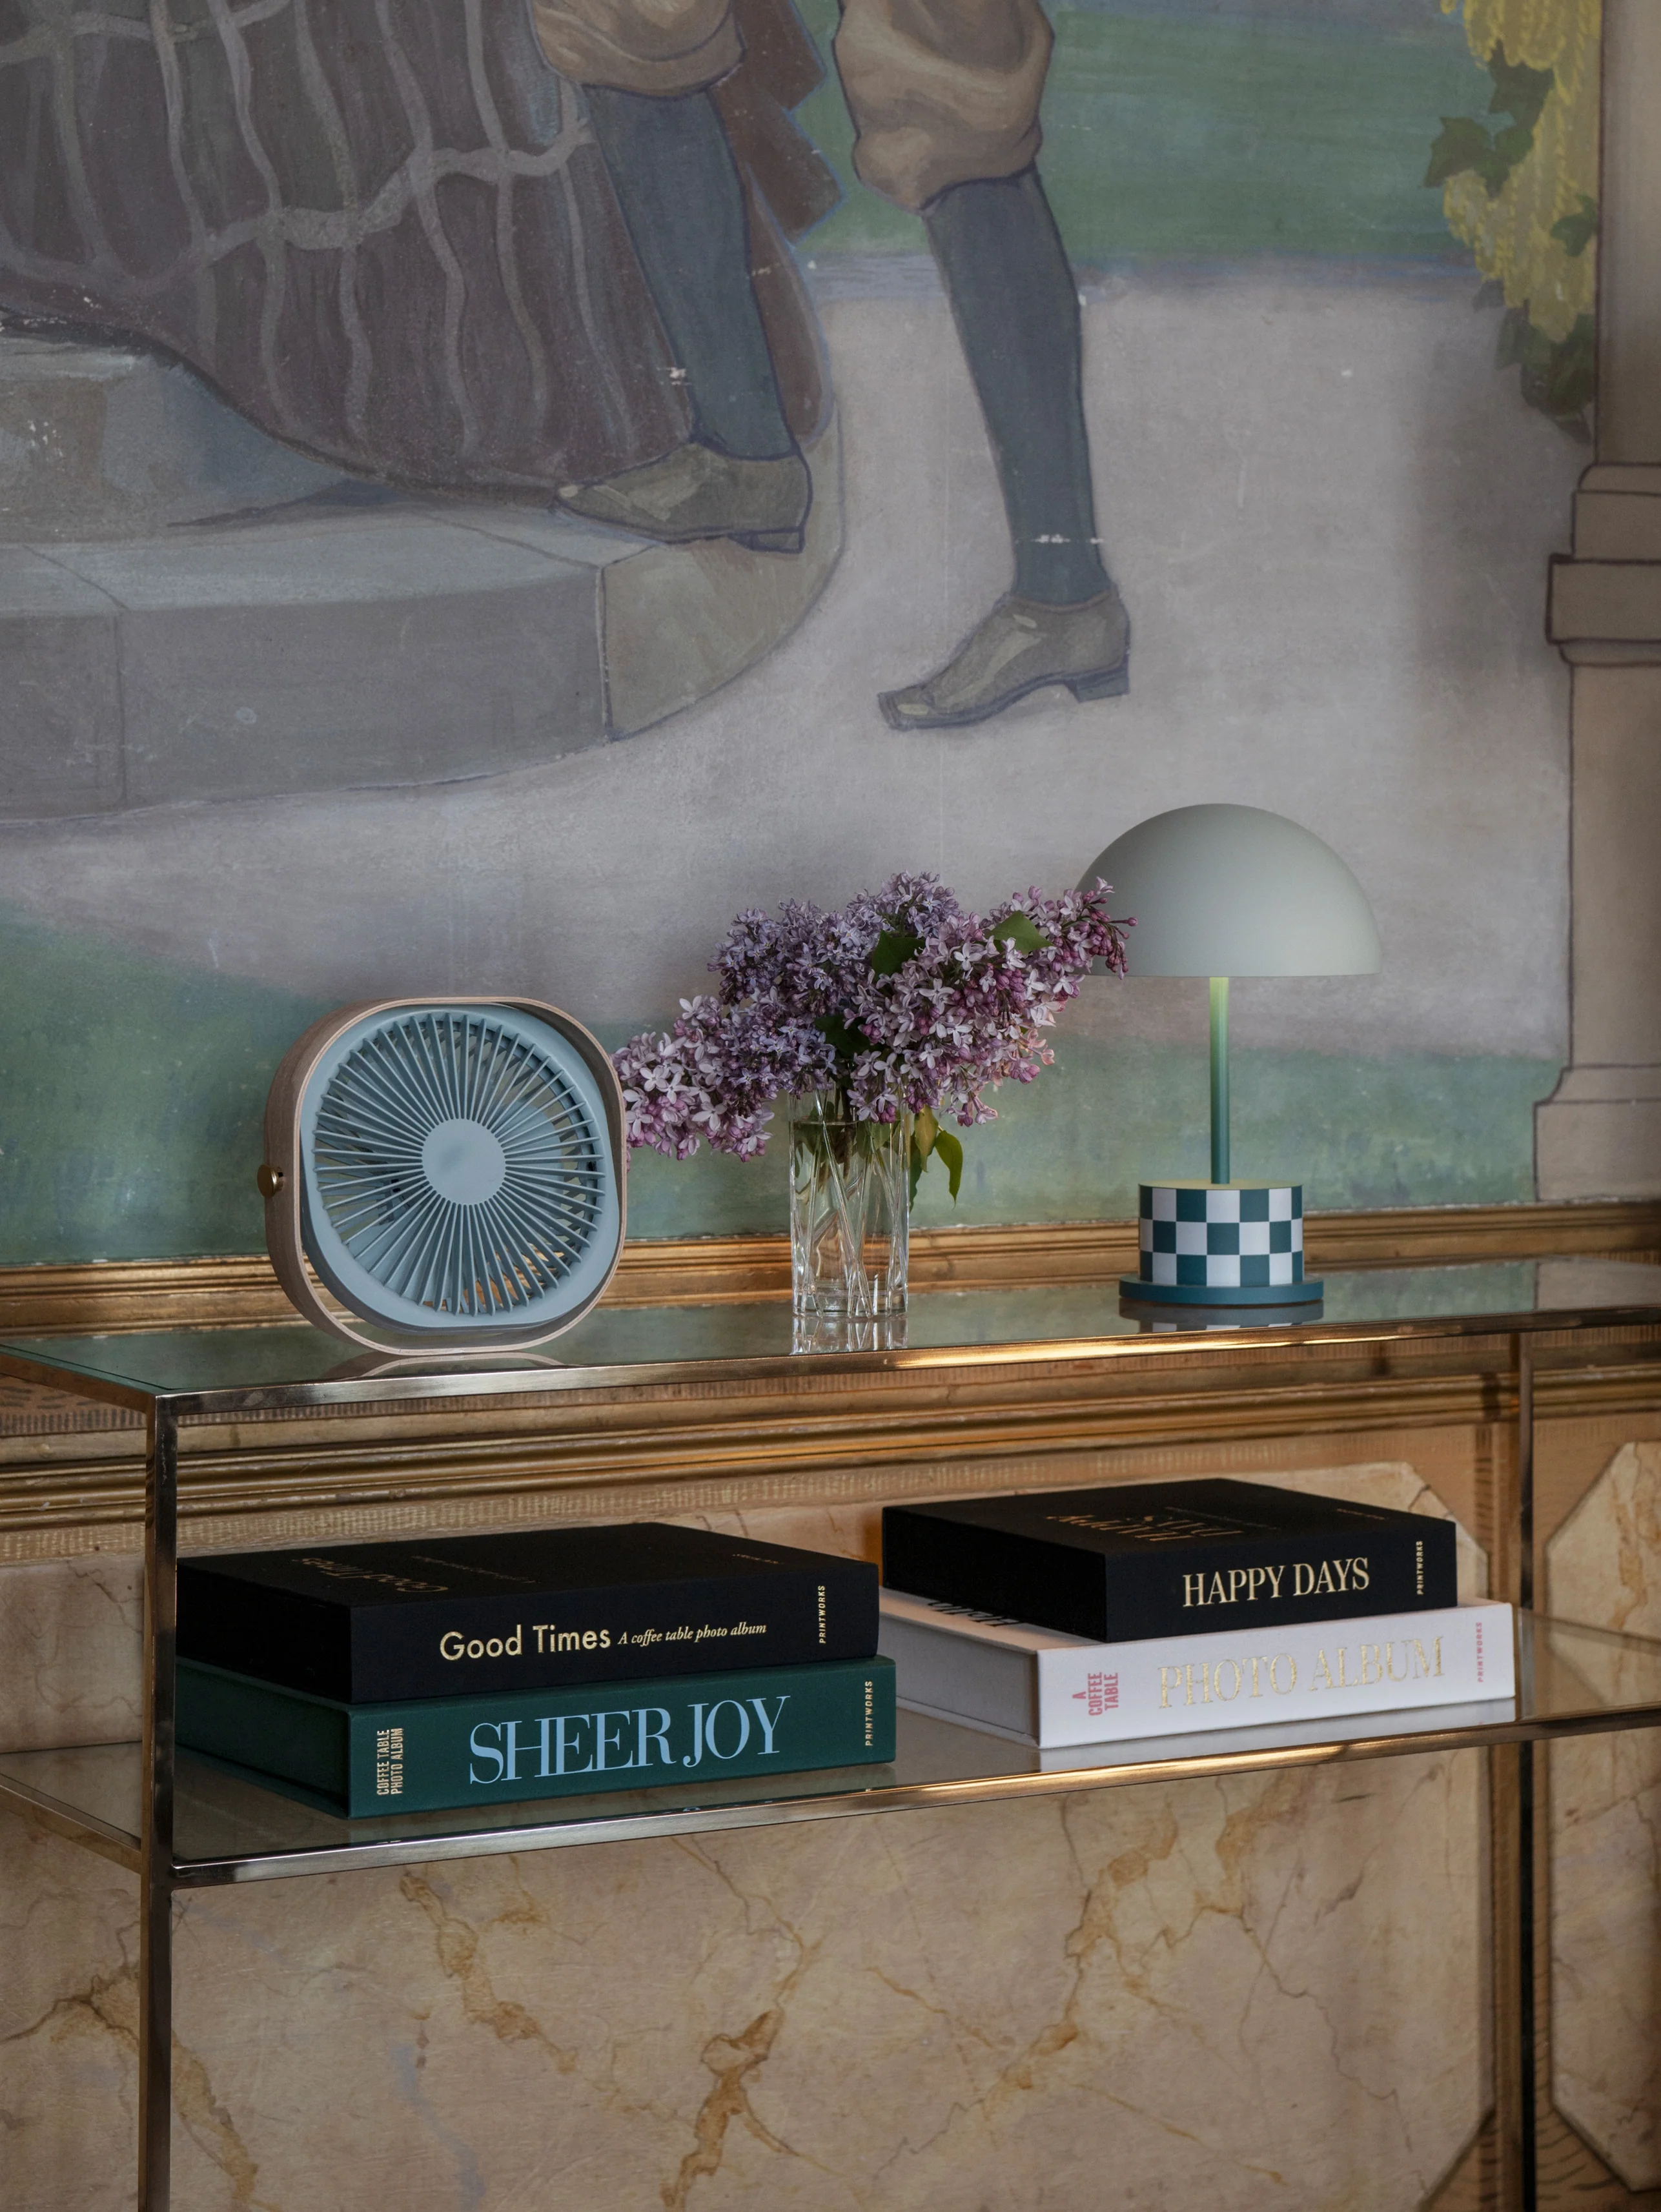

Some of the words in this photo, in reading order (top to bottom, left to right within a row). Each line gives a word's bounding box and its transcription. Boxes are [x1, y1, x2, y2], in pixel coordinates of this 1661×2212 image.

[1183, 1565, 1285, 1607] HAPPY
[1293, 1558, 1369, 1596] DAYS
[440, 1624, 522, 1660] Good
[533, 1625, 611, 1652] Times
[617, 1631, 628, 1645] A
[631, 1629, 662, 1647] coffee
[665, 1626, 693, 1641] table
[694, 1625, 728, 1643] photo
[730, 1621, 767, 1636] album
[1104, 1672, 1119, 1711] TABLE
[1158, 1653, 1297, 1709] PHOTO
[1308, 1636, 1445, 1692] ALBUM
[1088, 1672, 1103, 1716] COFFEE
[377, 1730, 390, 1759] TABLE
[391, 1728, 404, 1760] ALBUM
[470, 1708, 676, 1784] SHEER
[683, 1696, 790, 1767] JOY
[377, 1761, 389, 1795] COFFEE
[391, 1763, 403, 1794] PHOTO
